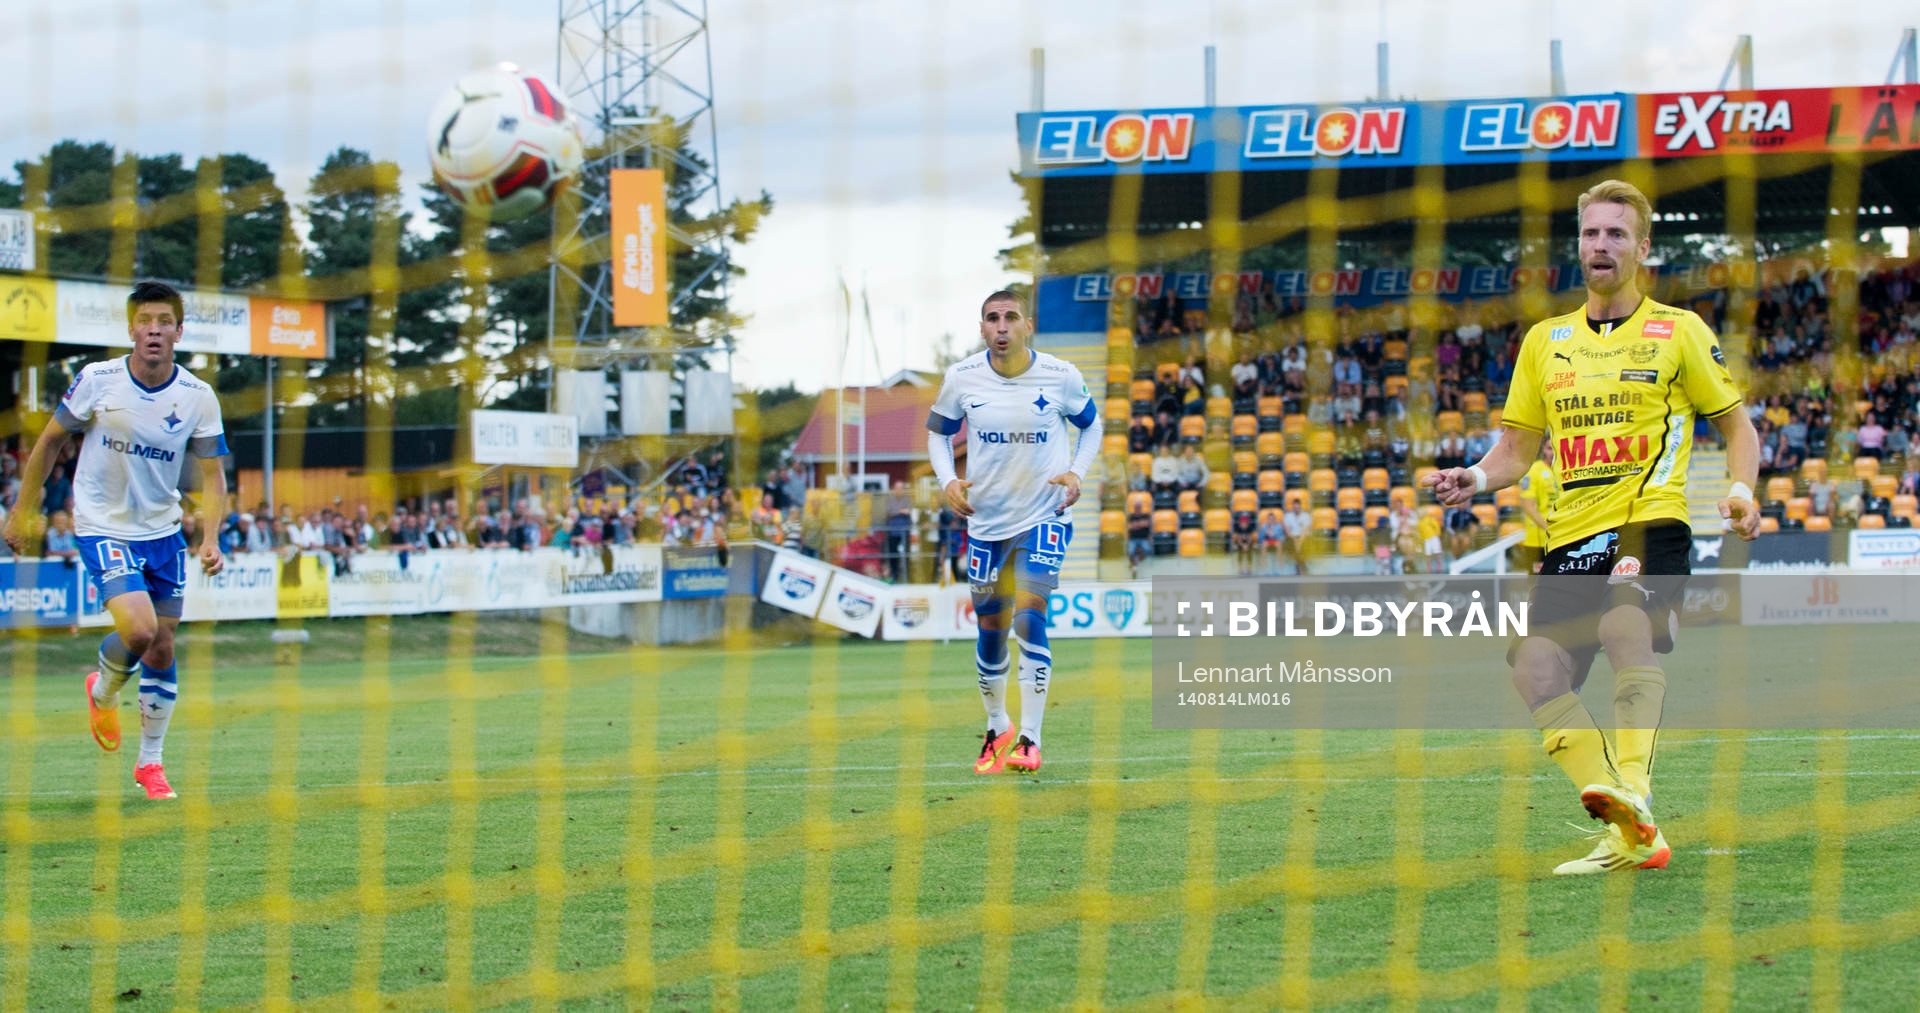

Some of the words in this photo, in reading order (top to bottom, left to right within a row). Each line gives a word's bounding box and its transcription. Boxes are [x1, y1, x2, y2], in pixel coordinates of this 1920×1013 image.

[1460, 99, 1621, 151] ELON
[1653, 95, 1792, 150] EXTRA
[1825, 89, 1920, 145] LÄ
[1034, 114, 1194, 164] ELON
[1244, 107, 1405, 158] ELON
[1074, 272, 1163, 301] ELON
[1175, 271, 1263, 299] ELON
[1274, 269, 1361, 297] ELON
[1371, 267, 1461, 295] ELON
[1554, 393, 1589, 413] STÅL
[1593, 396, 1605, 408] &
[1609, 390, 1643, 407] RÖR
[1561, 410, 1635, 430] MONTAGE
[102, 435, 175, 463] HOLMEN
[978, 431, 1048, 444] HOLMEN
[1559, 435, 1649, 472] MAXI
[1046, 592, 1095, 628] PS
